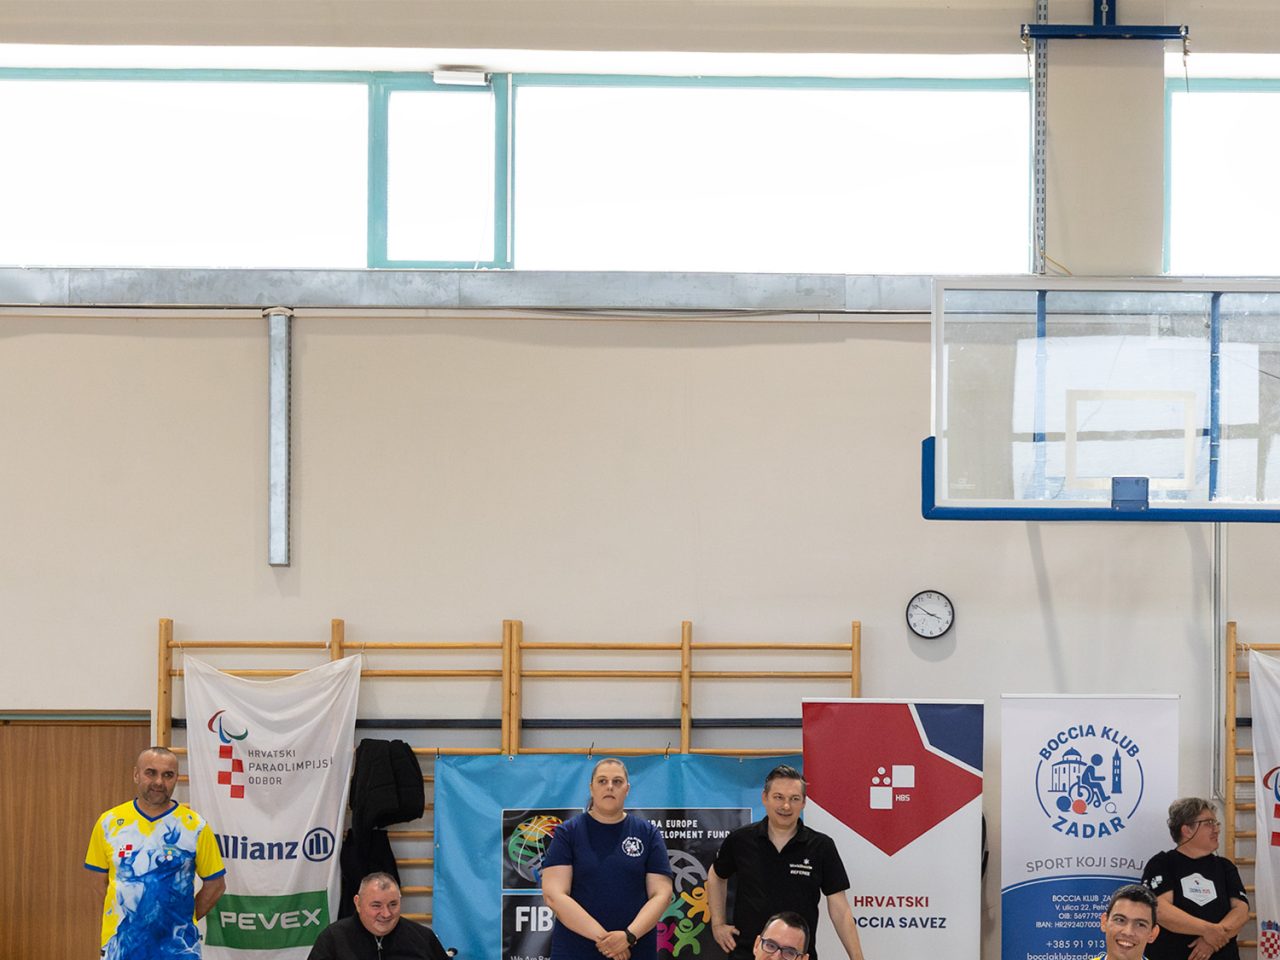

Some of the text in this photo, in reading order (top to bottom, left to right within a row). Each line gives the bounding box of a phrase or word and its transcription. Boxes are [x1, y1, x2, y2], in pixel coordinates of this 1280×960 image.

[1039, 724, 1140, 761] BOCCIA KLUB
[248, 749, 296, 758] HRVATSKI
[248, 776, 282, 785] ODBOR
[665, 819, 698, 828] EUROPE
[1052, 815, 1126, 838] ZADAR
[660, 830, 703, 839] ELOPMENT
[1026, 857, 1144, 873] SPORT KOJI SPAJ
[854, 895, 929, 908] HRVATSKI
[1052, 894, 1081, 902] BOCCIA
[1082, 894, 1099, 902] KLUB
[220, 908, 322, 931] PEVEX
[515, 905, 555, 932] FIB
[1073, 912, 1102, 920] 5697795
[898, 917, 947, 929] SAVEZ
[1035, 921, 1101, 929] IBAN: HR292407000
[1046, 940, 1105, 949] +385 91 913
[1026, 951, 1107, 960] bocciaklubzadar@
